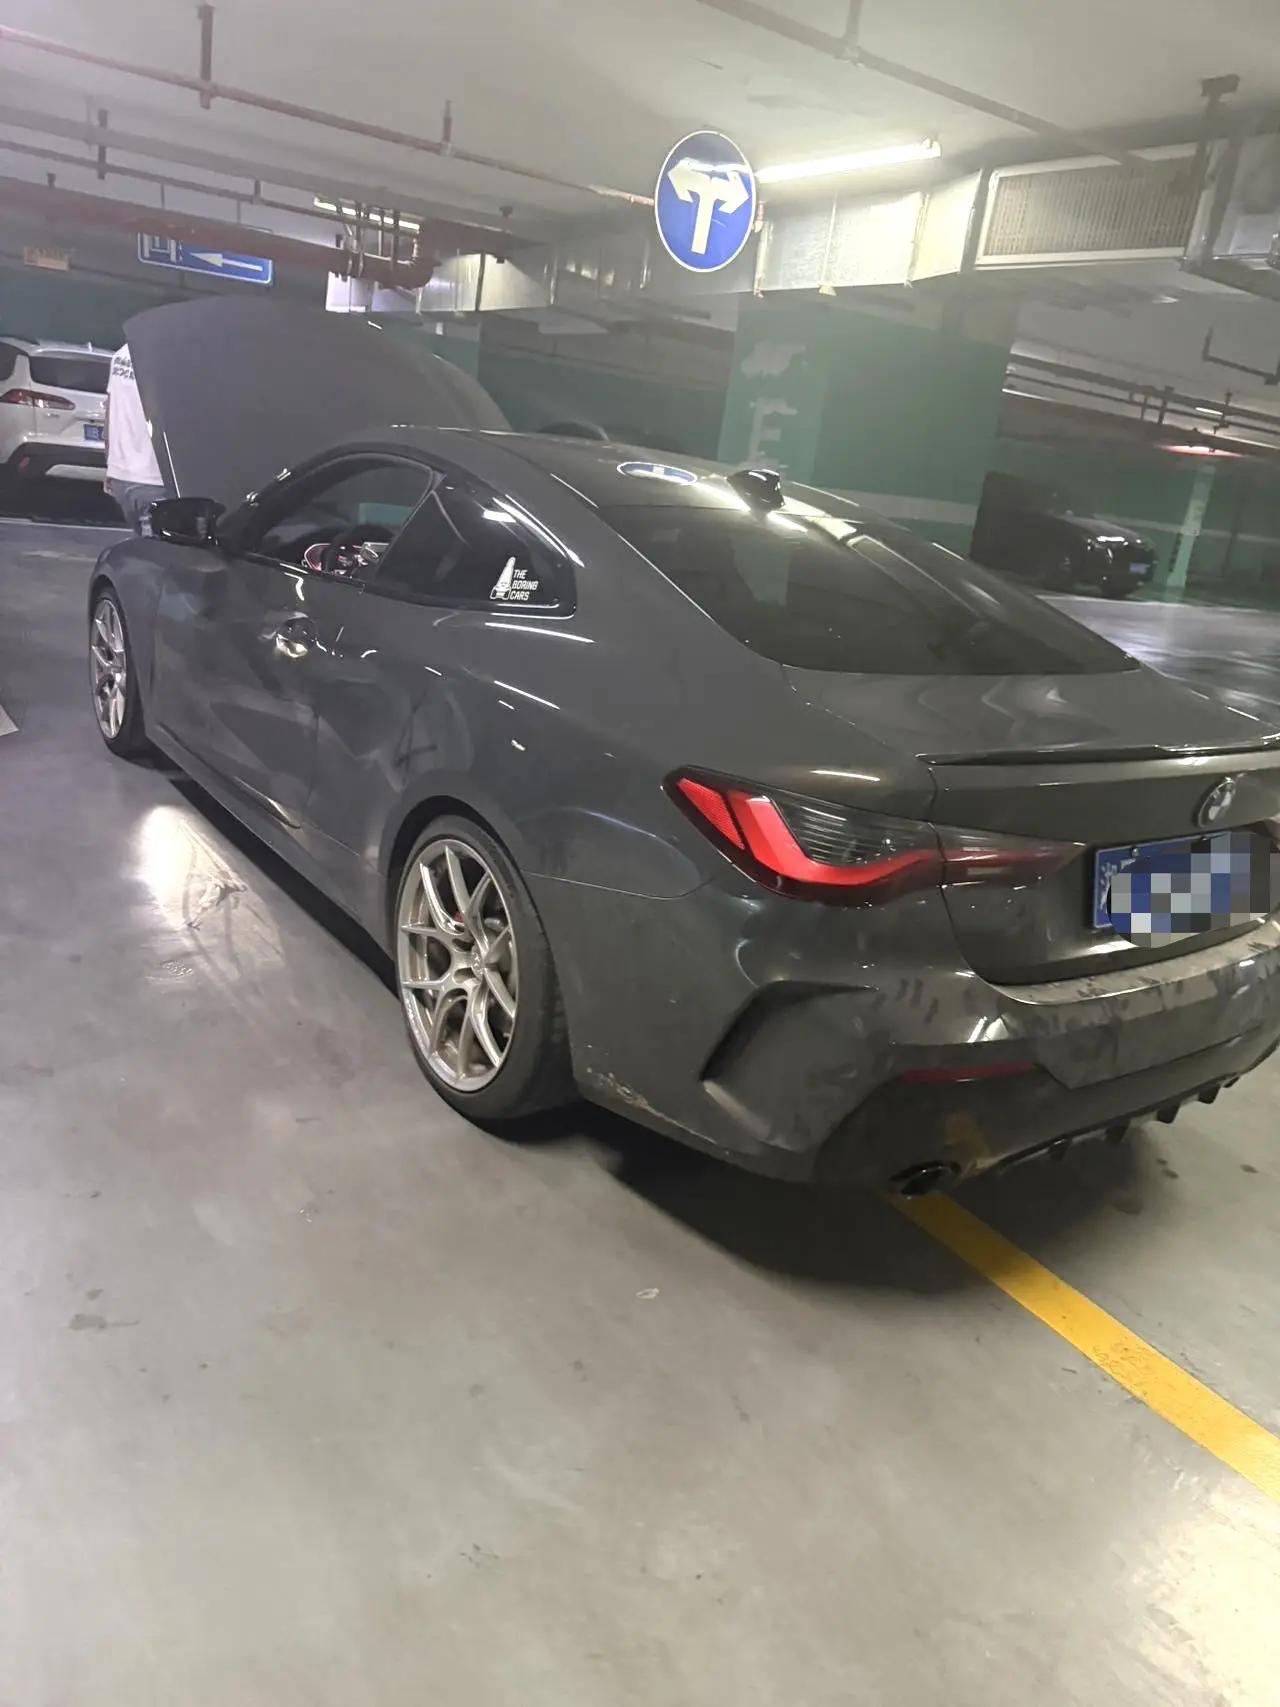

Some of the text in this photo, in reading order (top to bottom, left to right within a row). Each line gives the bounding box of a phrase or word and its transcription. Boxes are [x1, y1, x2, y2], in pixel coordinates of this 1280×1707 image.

[513, 569, 528, 579] THE
[511, 580, 539, 590] BORING
[510, 590, 530, 600] CARS
